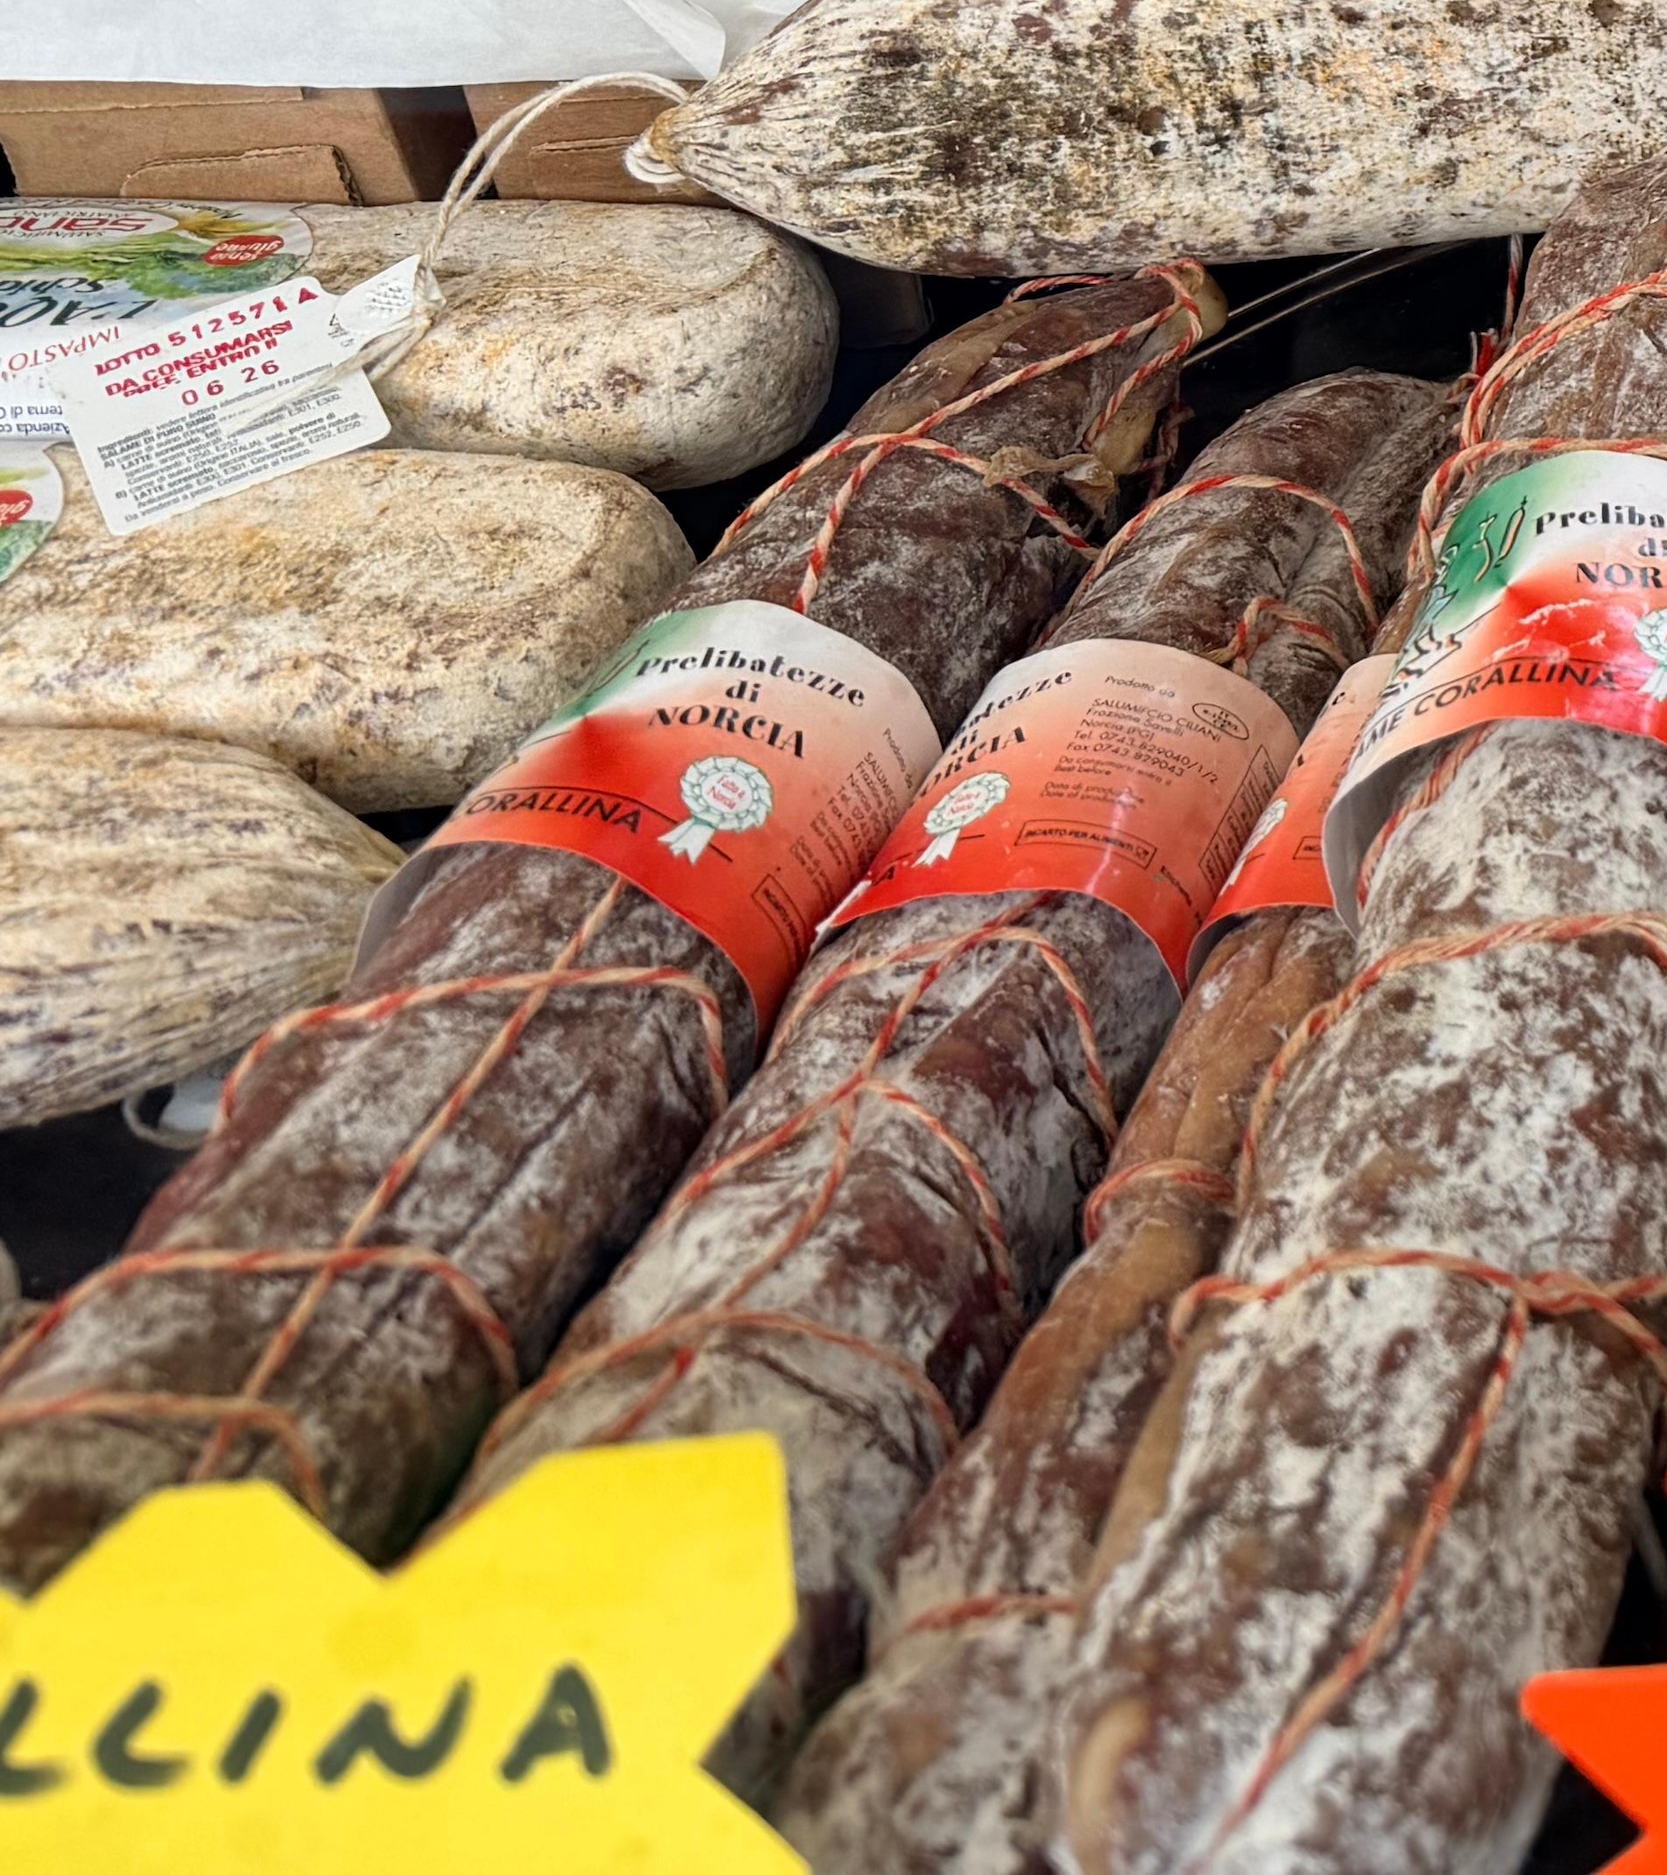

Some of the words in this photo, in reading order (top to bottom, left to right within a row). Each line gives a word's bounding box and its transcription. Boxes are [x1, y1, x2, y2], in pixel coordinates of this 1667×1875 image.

[8, 325, 120, 373] IMPASTO
[105, 377, 139, 396] DA
[142, 320, 294, 382] CONSUMARSI
[16, 422, 69, 435] Azienda
[635, 646, 866, 708] Prelibatezze
[725, 680, 761, 703] di
[1104, 674, 1157, 694] Prodotto
[1414, 660, 1623, 718] CORALLINA
[647, 703, 807, 759] NORCIA
[1079, 718, 1126, 735] Norcia
[1085, 707, 1142, 727] Frazione
